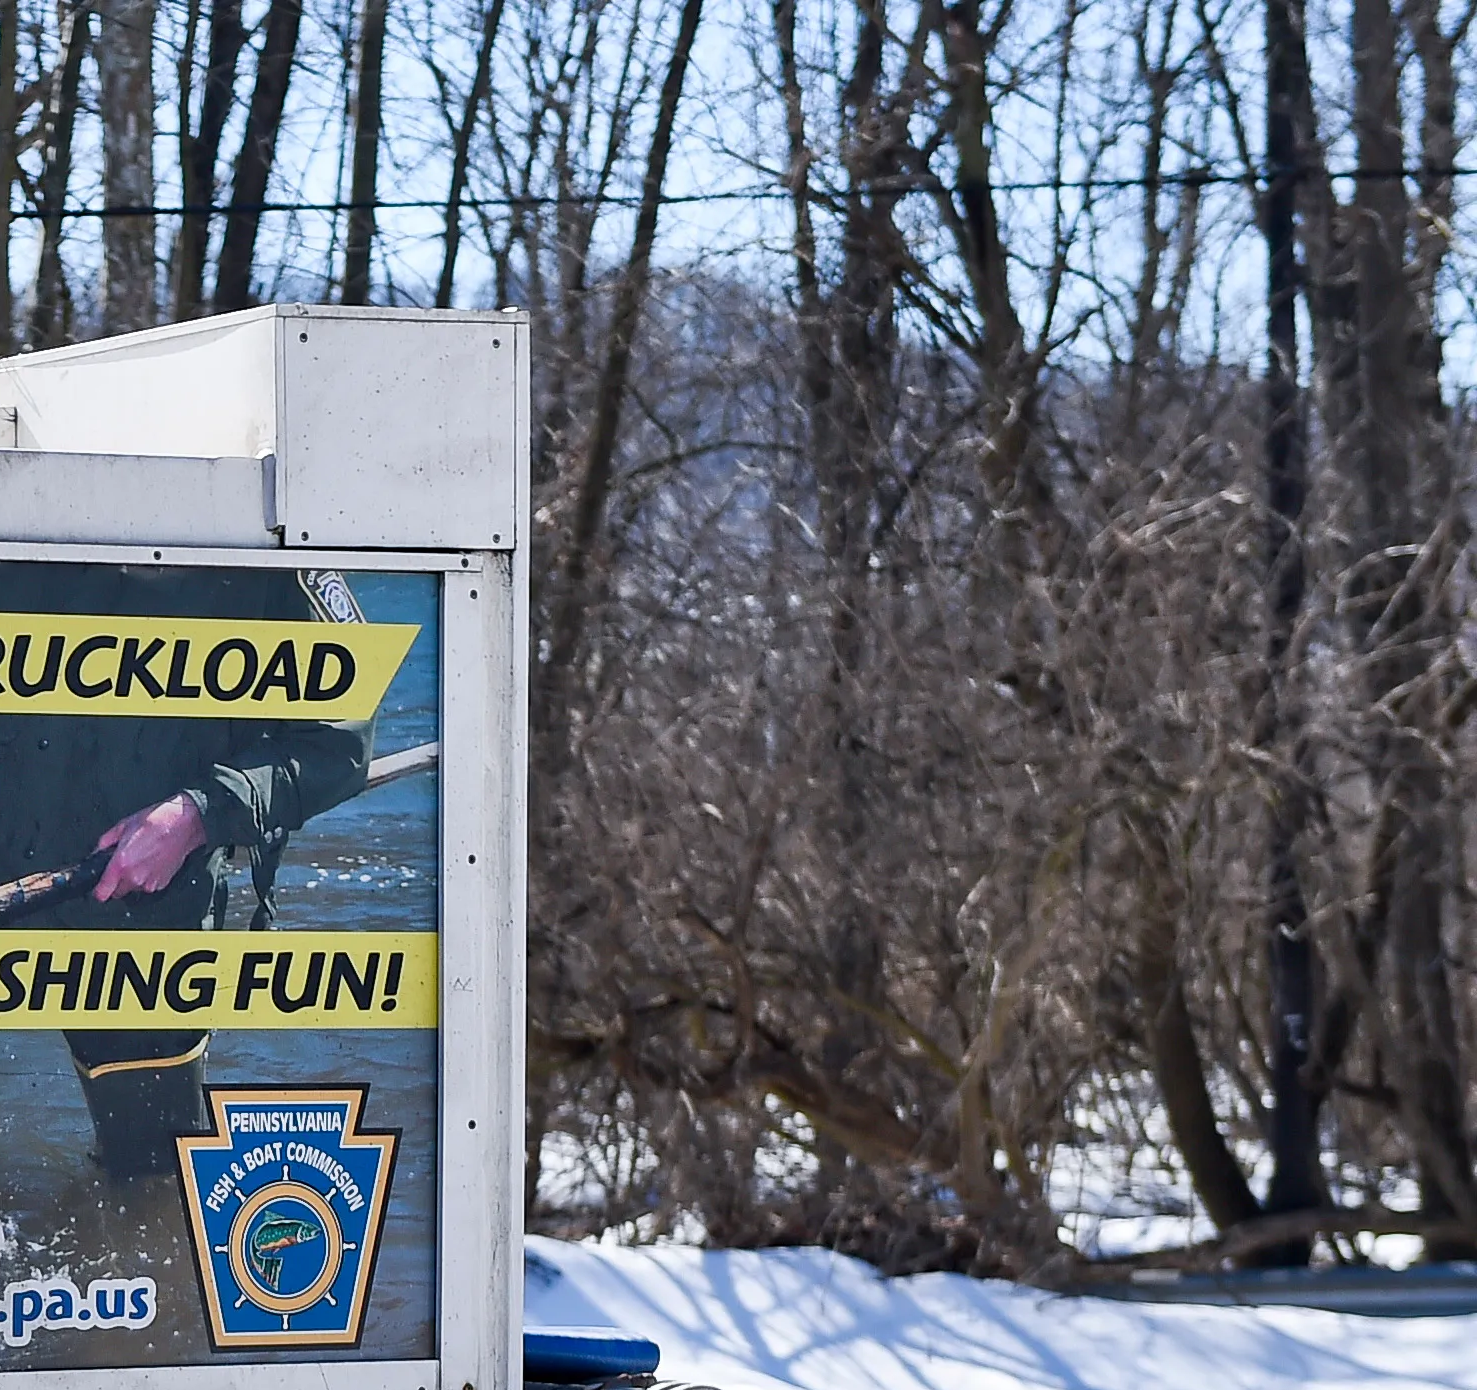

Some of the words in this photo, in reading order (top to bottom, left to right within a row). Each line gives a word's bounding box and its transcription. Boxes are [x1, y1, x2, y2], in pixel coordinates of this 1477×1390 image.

[233, 951, 405, 1014] FUN!
[230, 1111, 343, 1133] PENNSYLVANIA
[205, 1173, 236, 1213] FISH
[230, 1162, 247, 1181] &
[242, 1142, 283, 1171] BOAT
[286, 1142, 365, 1213] COMMISSION
